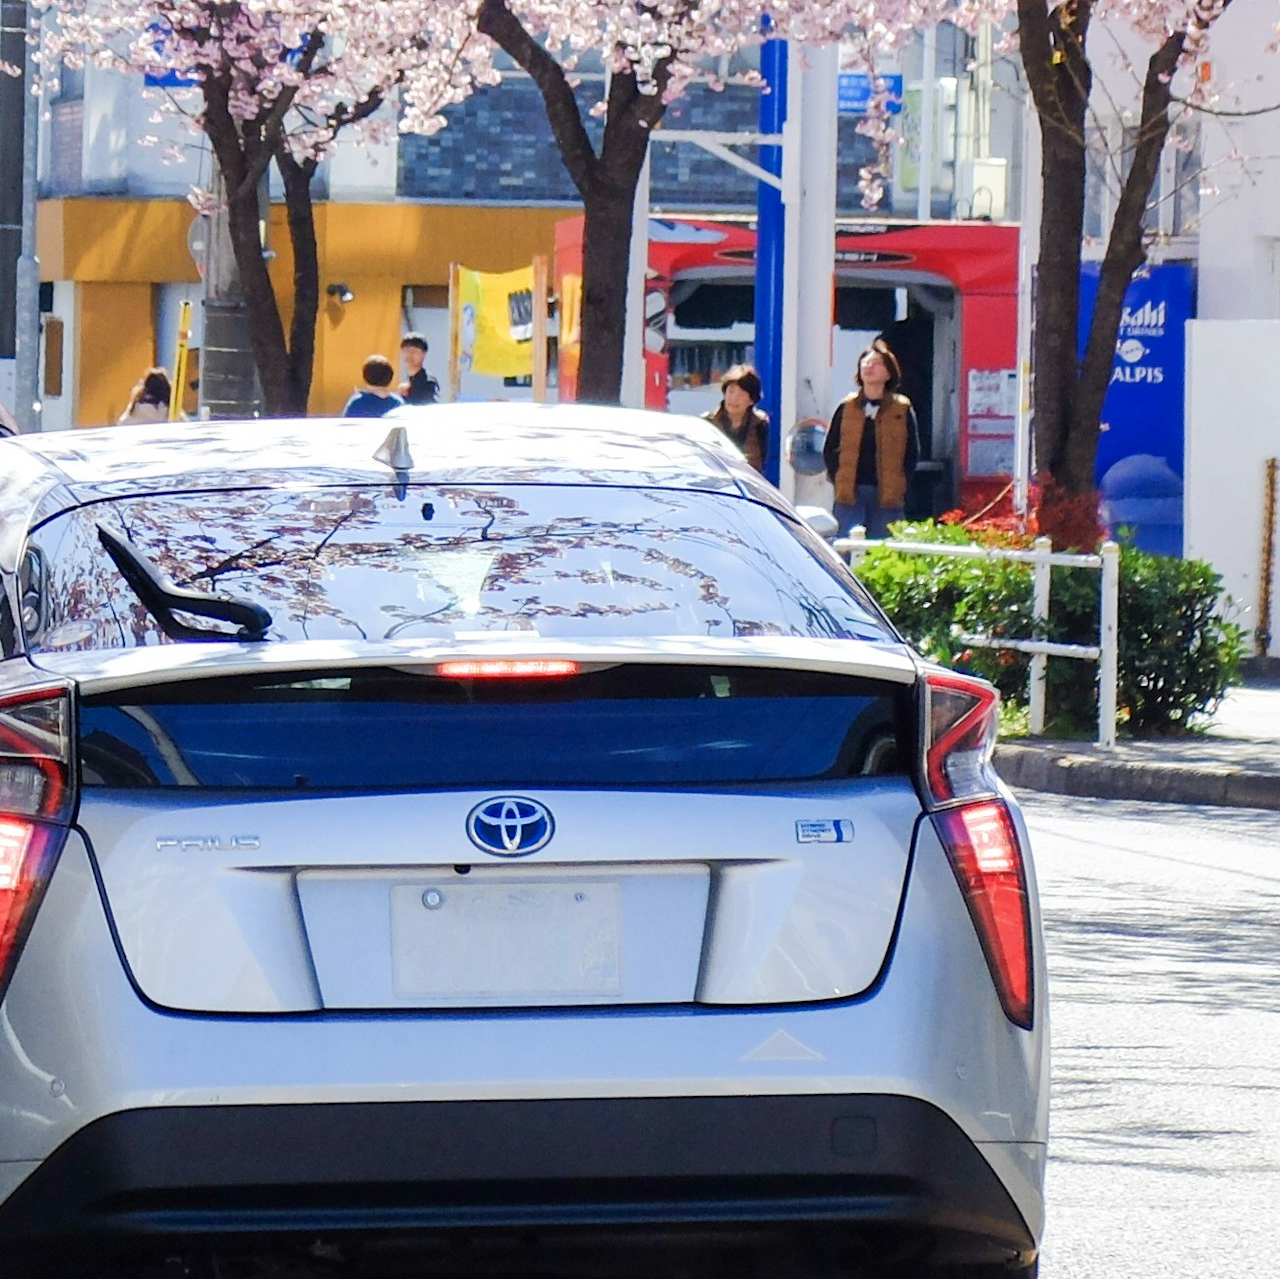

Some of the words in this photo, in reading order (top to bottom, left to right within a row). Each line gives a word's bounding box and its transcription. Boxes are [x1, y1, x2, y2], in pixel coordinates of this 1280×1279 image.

[1120, 301, 1166, 327] sahi
[1108, 366, 1164, 385] ALPIS
[156, 834, 261, 852] PRIUS
